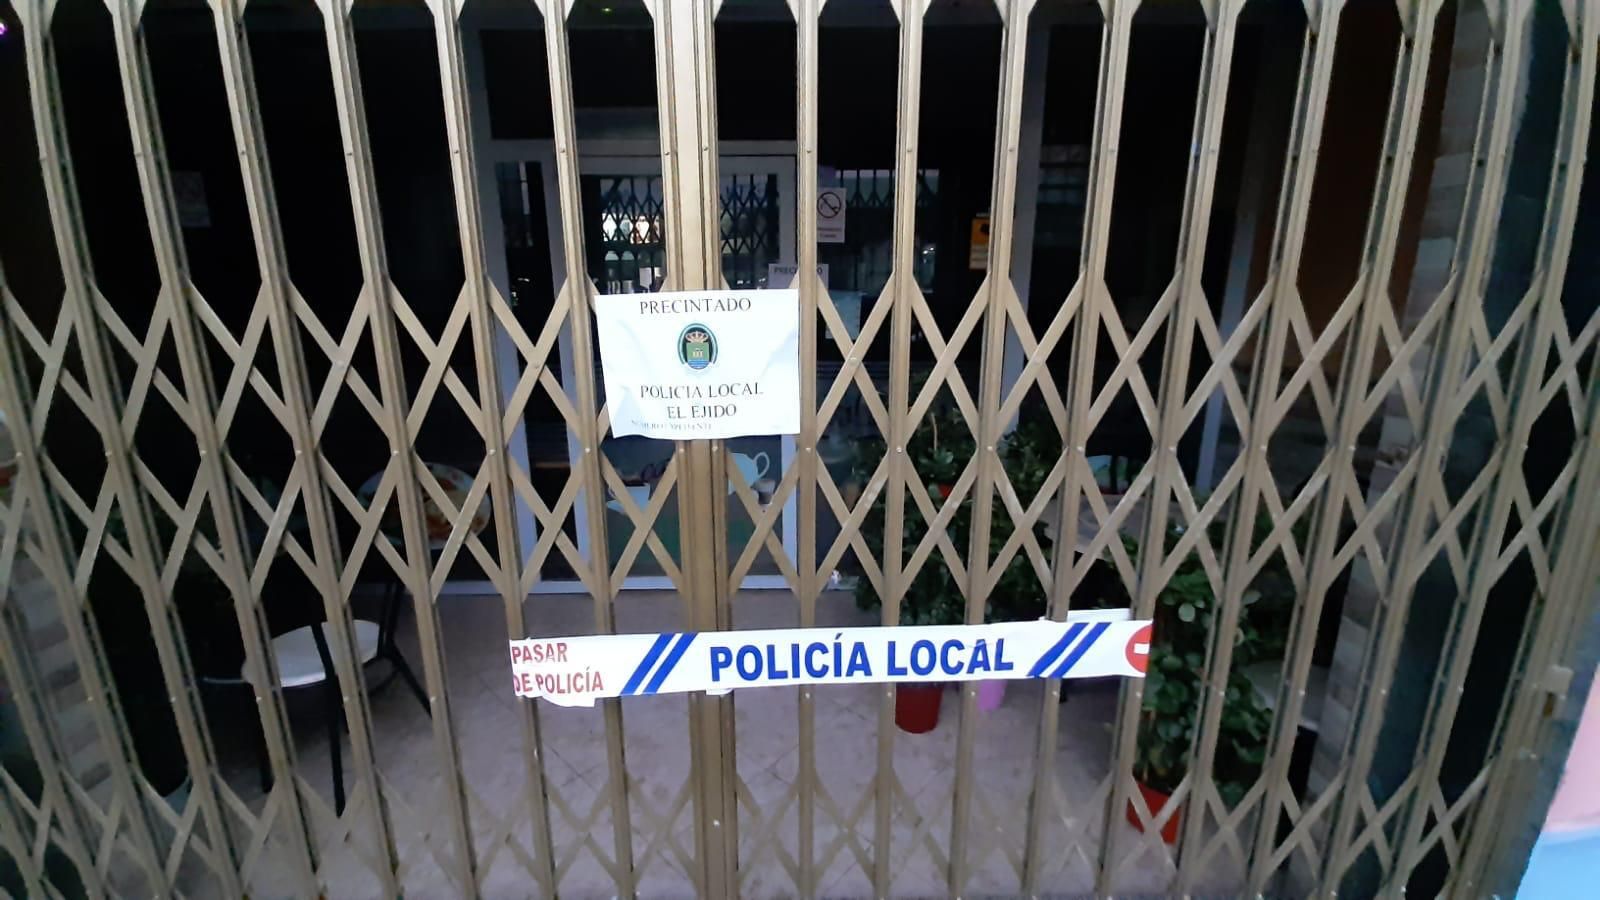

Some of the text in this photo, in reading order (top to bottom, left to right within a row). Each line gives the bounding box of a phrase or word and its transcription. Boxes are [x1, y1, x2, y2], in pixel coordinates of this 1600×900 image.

[640, 297, 751, 314] PRECINTADO
[709, 382, 763, 398] LOCAL
[667, 404, 737, 419] EL EJIDO
[511, 643, 568, 664] PASAR
[710, 633, 1014, 682] POLICÍA LOCAL
[513, 666, 604, 694] DE POLICÍA
